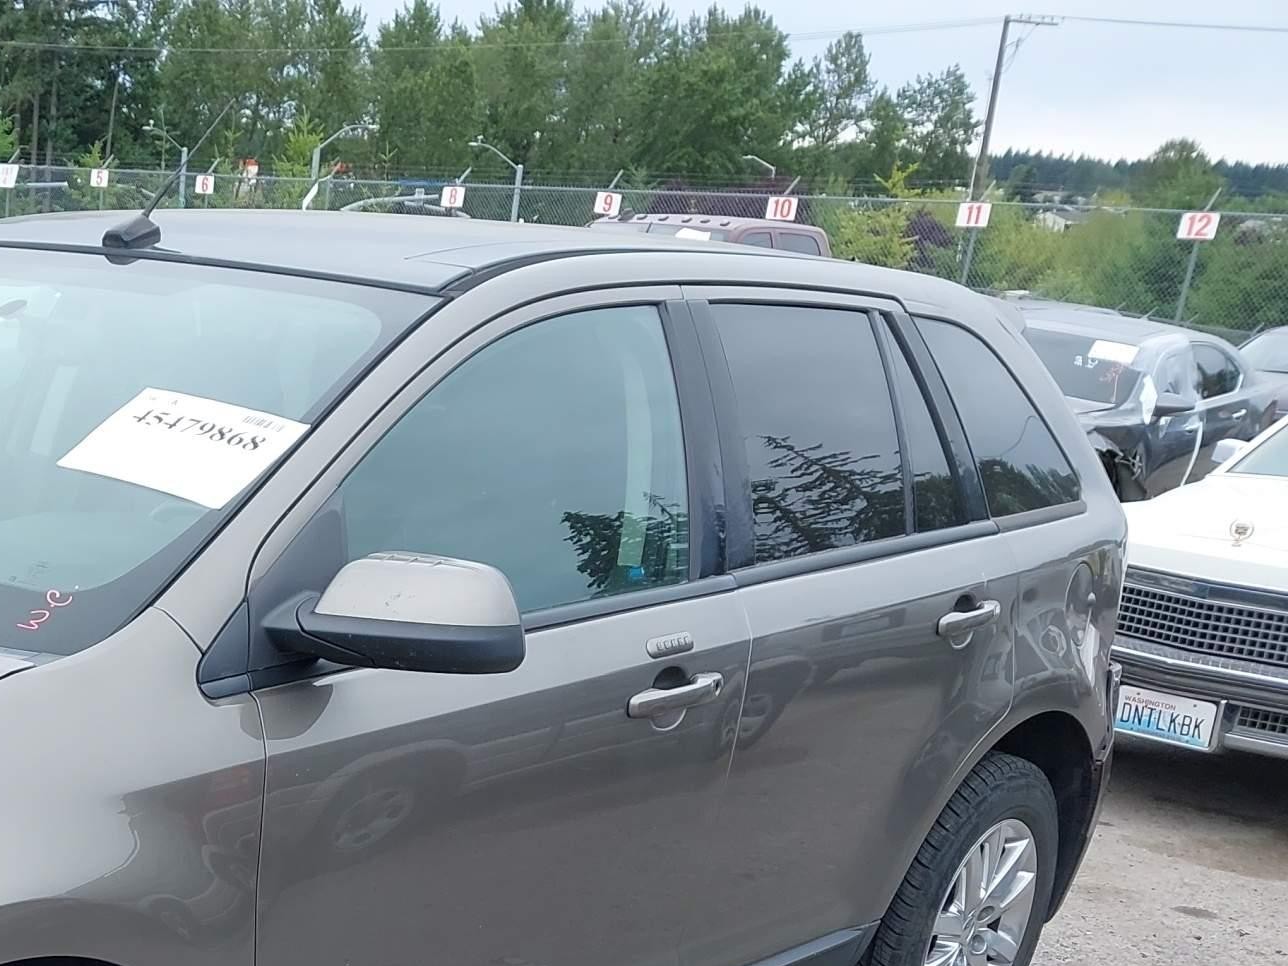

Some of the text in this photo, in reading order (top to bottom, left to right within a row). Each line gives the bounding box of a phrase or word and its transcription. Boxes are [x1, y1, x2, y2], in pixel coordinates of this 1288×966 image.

[95, 169, 104, 186] 5
[201, 176, 210, 193] 6
[449, 187, 459, 205] 8
[602, 194, 613, 212] 9
[772, 198, 793, 219] 10
[965, 204, 983, 226] 11
[1186, 213, 1213, 237] 12
[132, 408, 267, 452] 45479868
[1124, 695, 1177, 712] WASHINGTON
[1119, 701, 1206, 740] DNTLKBK
